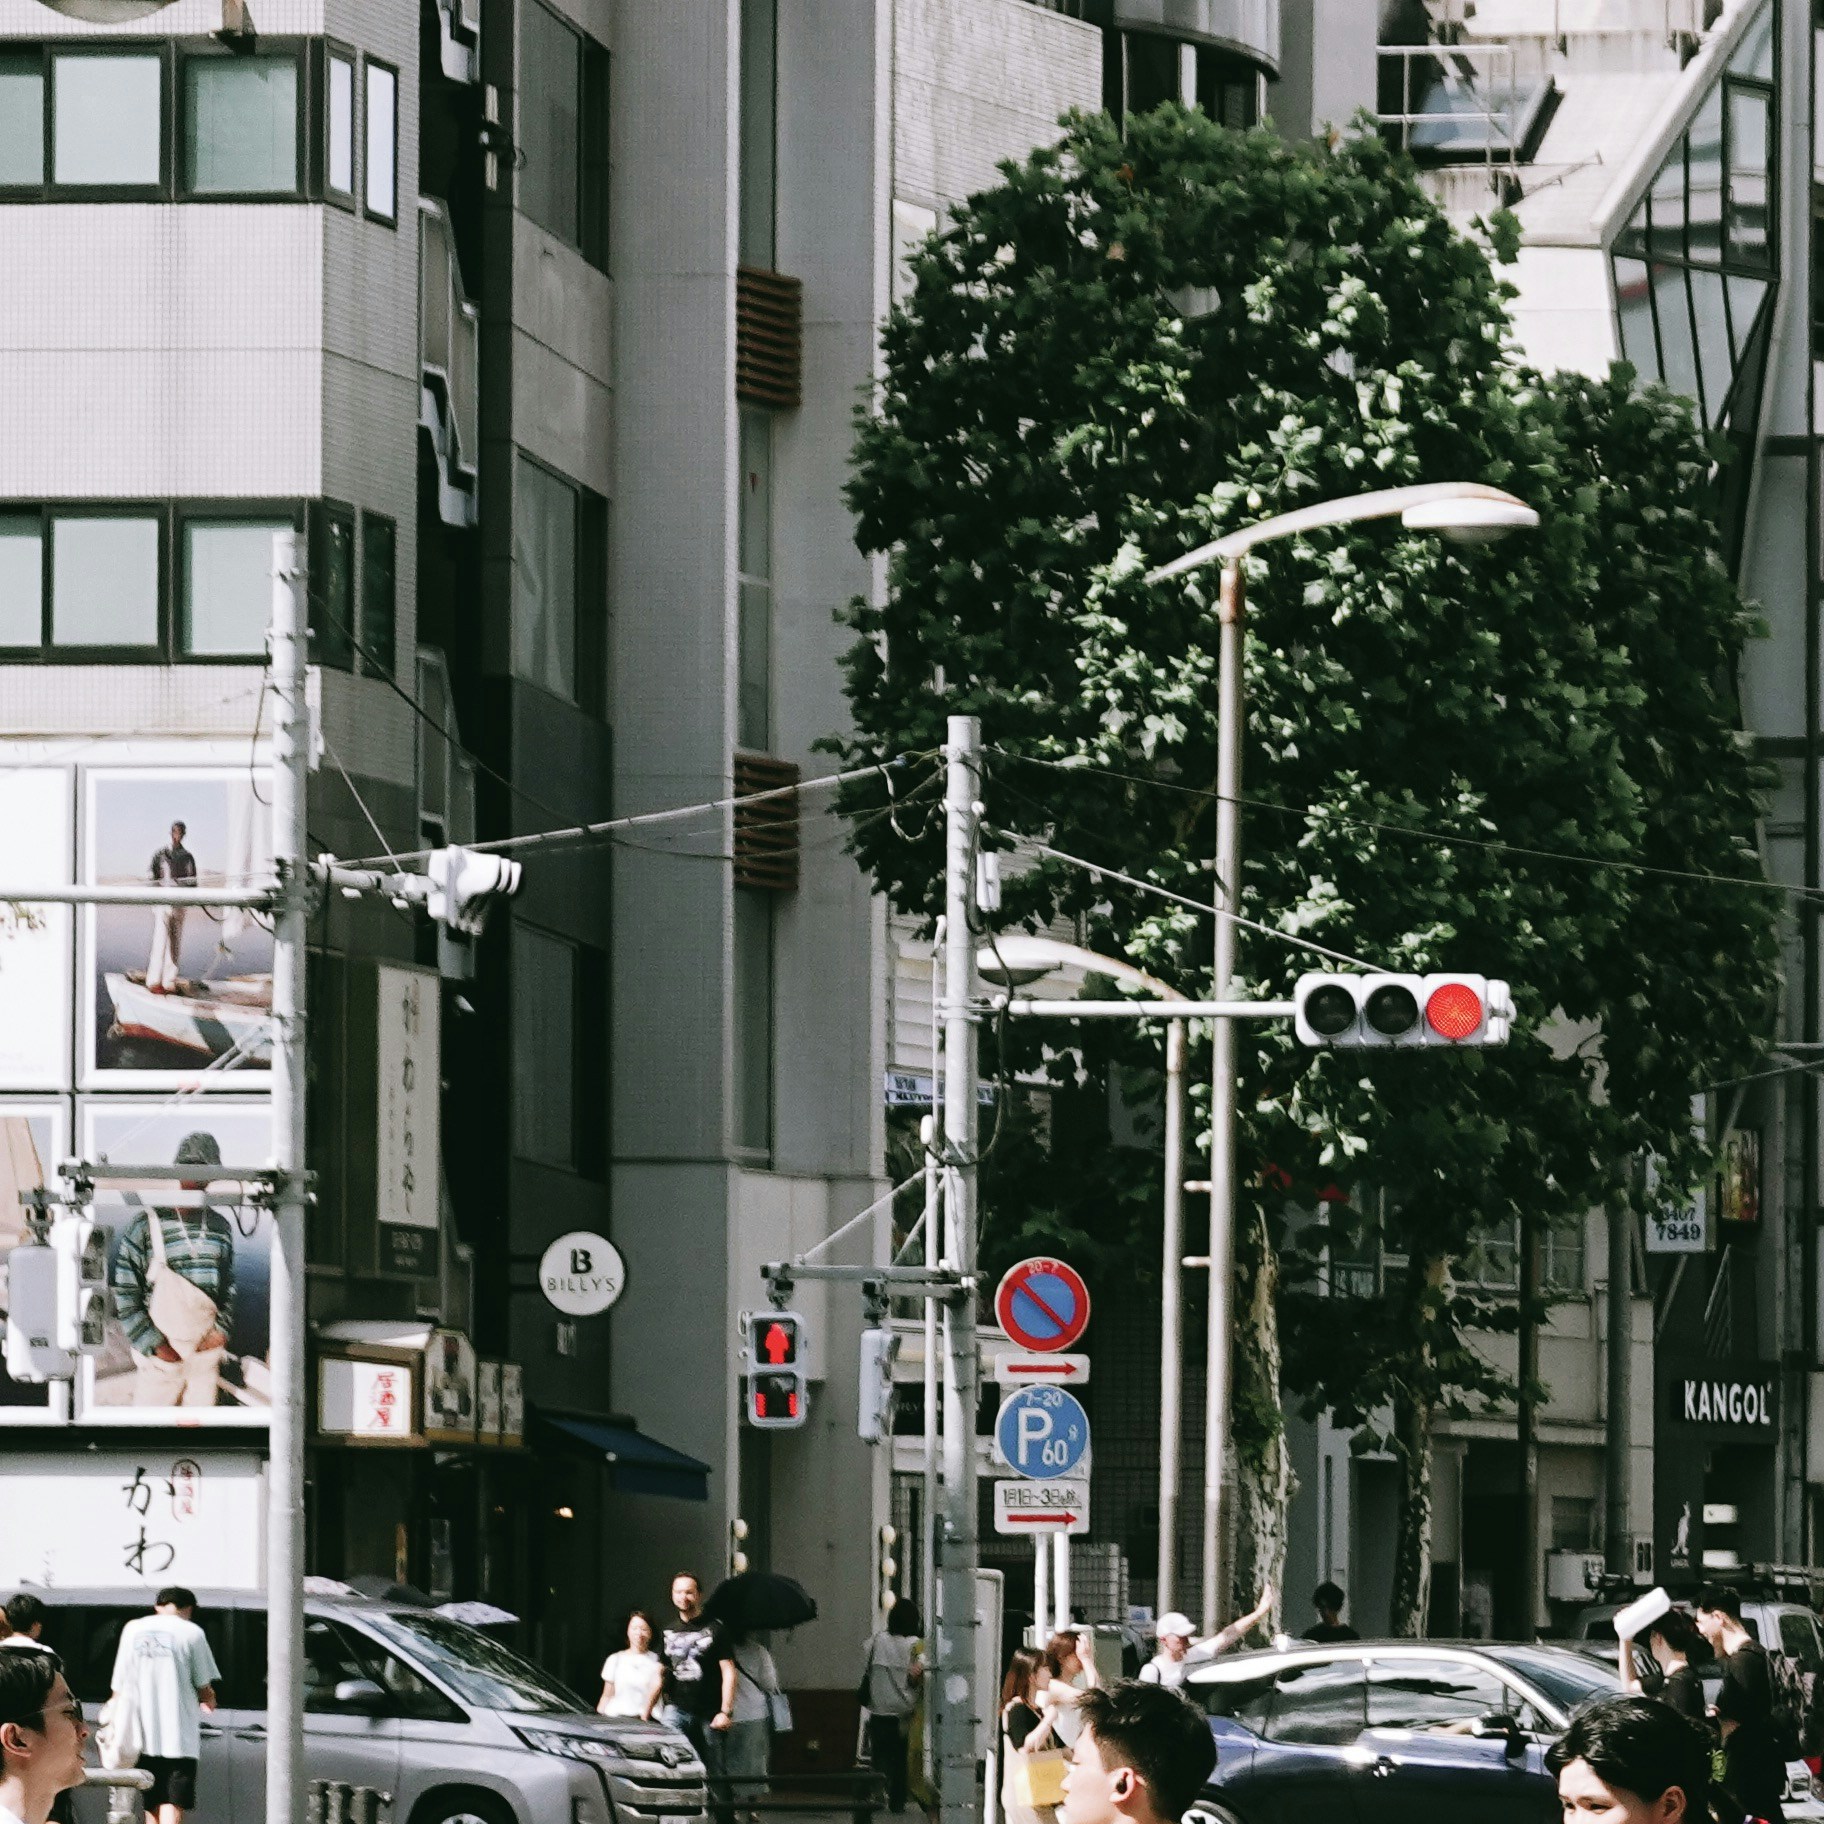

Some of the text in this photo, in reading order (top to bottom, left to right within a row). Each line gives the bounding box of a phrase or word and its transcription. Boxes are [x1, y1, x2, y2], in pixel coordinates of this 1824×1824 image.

[1655, 1223, 1701, 1241] 7849
[1024, 1391, 1064, 1408] 7-20
[1683, 1379, 1771, 1427] KANGOL
[1018, 1407, 1054, 1466] P
[1042, 1439, 1069, 1466] 60
